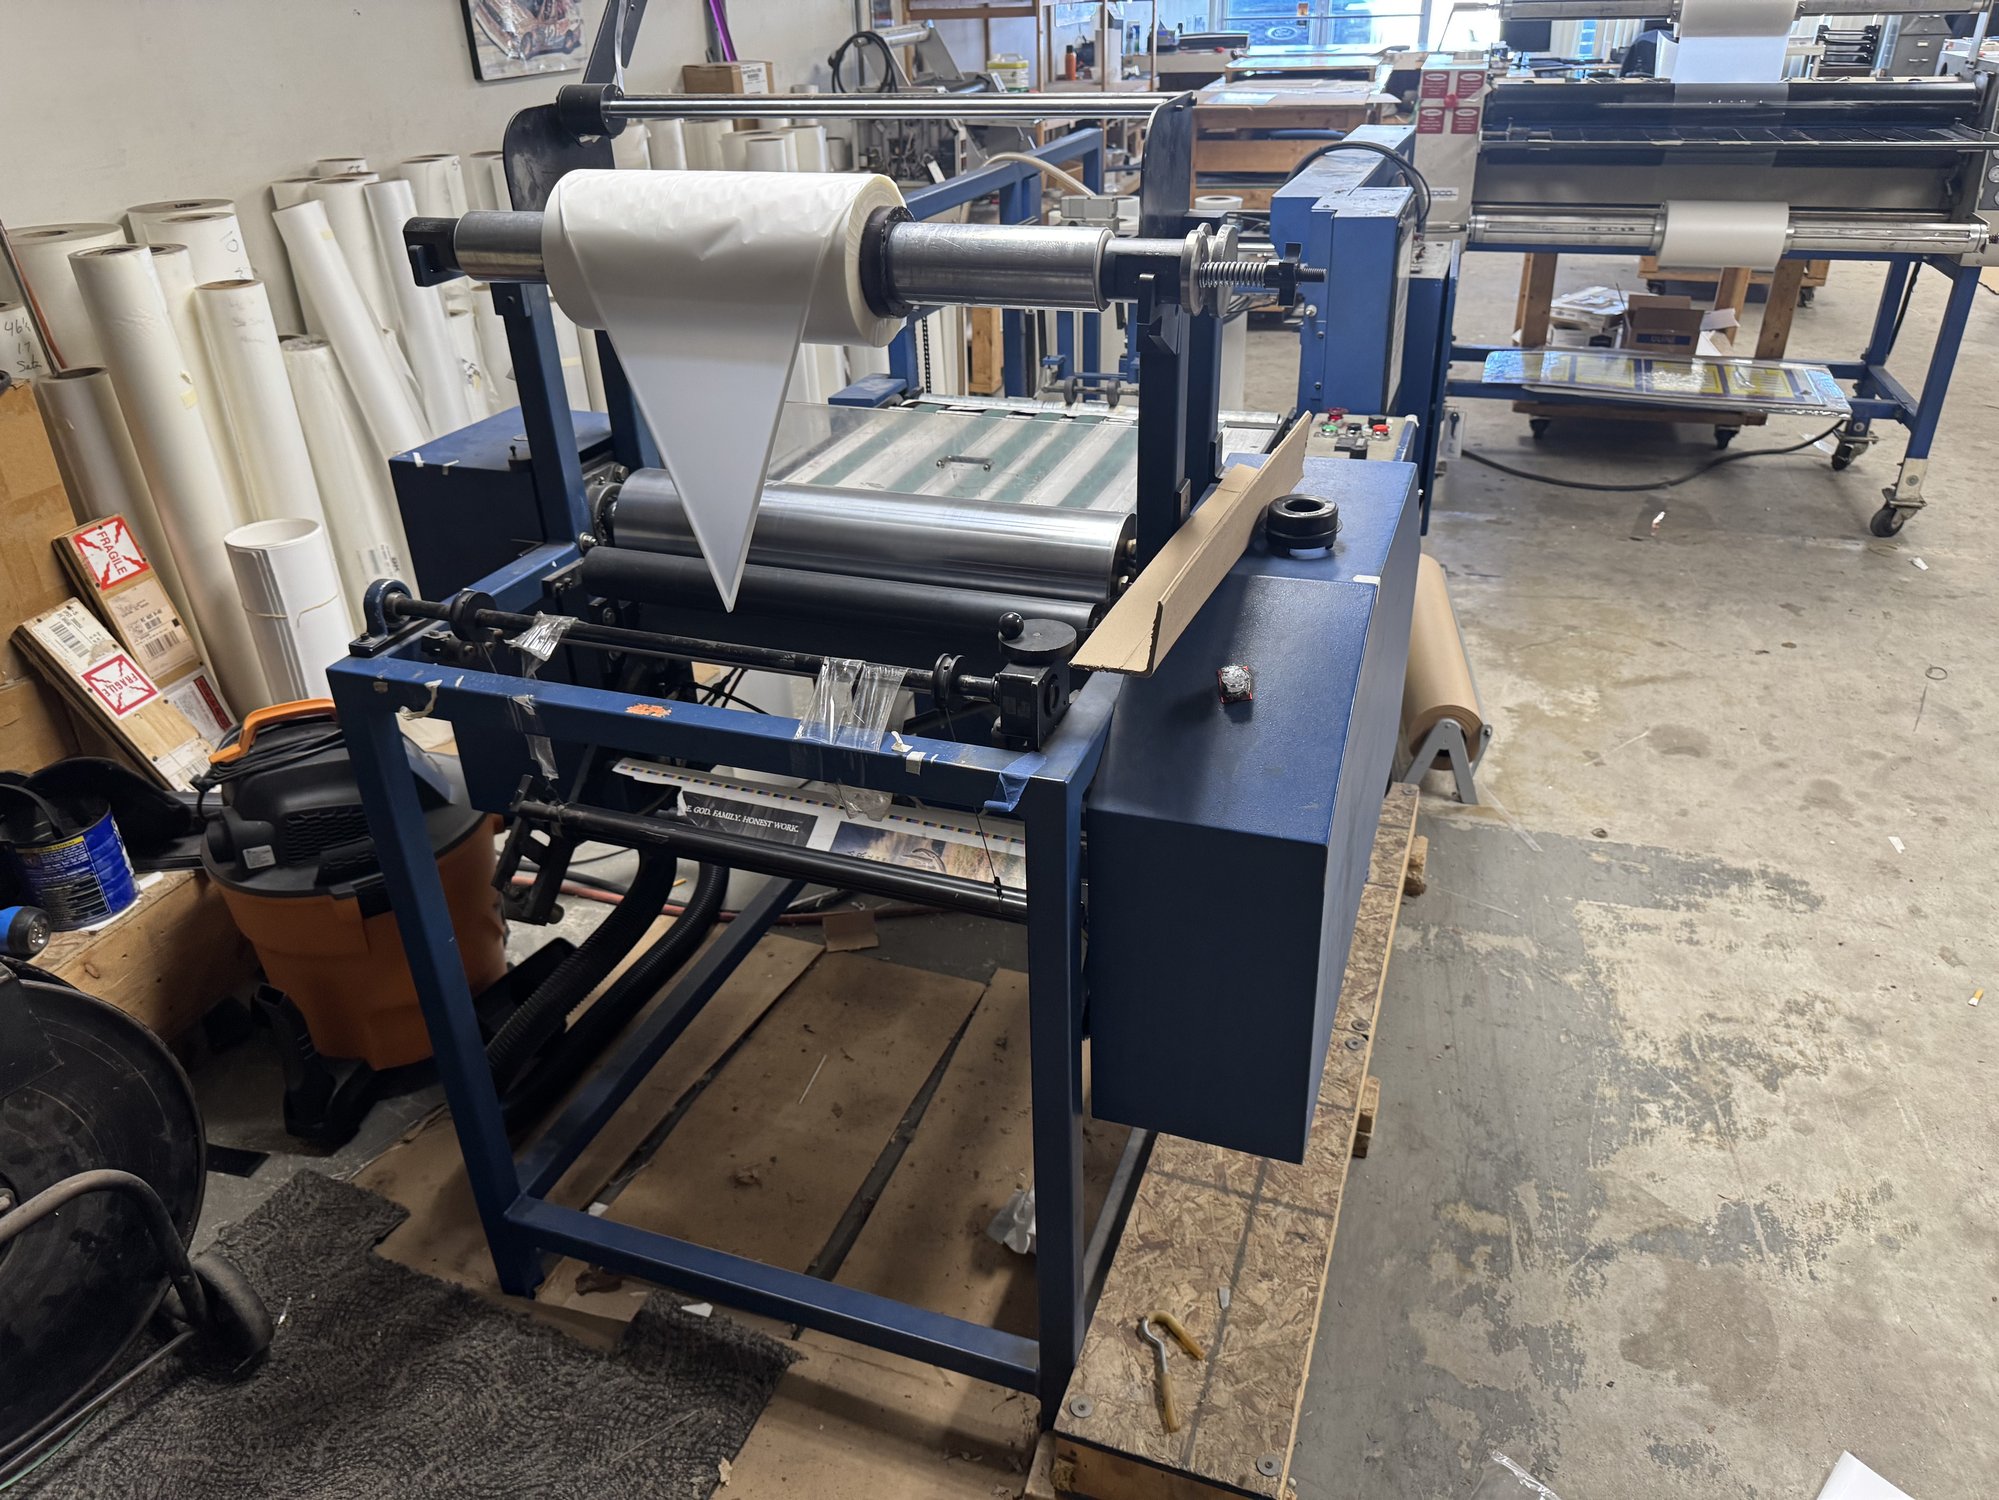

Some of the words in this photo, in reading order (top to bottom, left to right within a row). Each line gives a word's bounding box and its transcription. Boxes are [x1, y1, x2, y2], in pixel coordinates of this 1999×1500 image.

[97, 530, 127, 575] FRAGILE
[101, 672, 139, 697] FRAGILE
[693, 806, 711, 816] GOD.
[712, 809, 741, 823] FAMILY.
[742, 816, 774, 828] HONEST
[774, 822, 799, 833] WORK.
